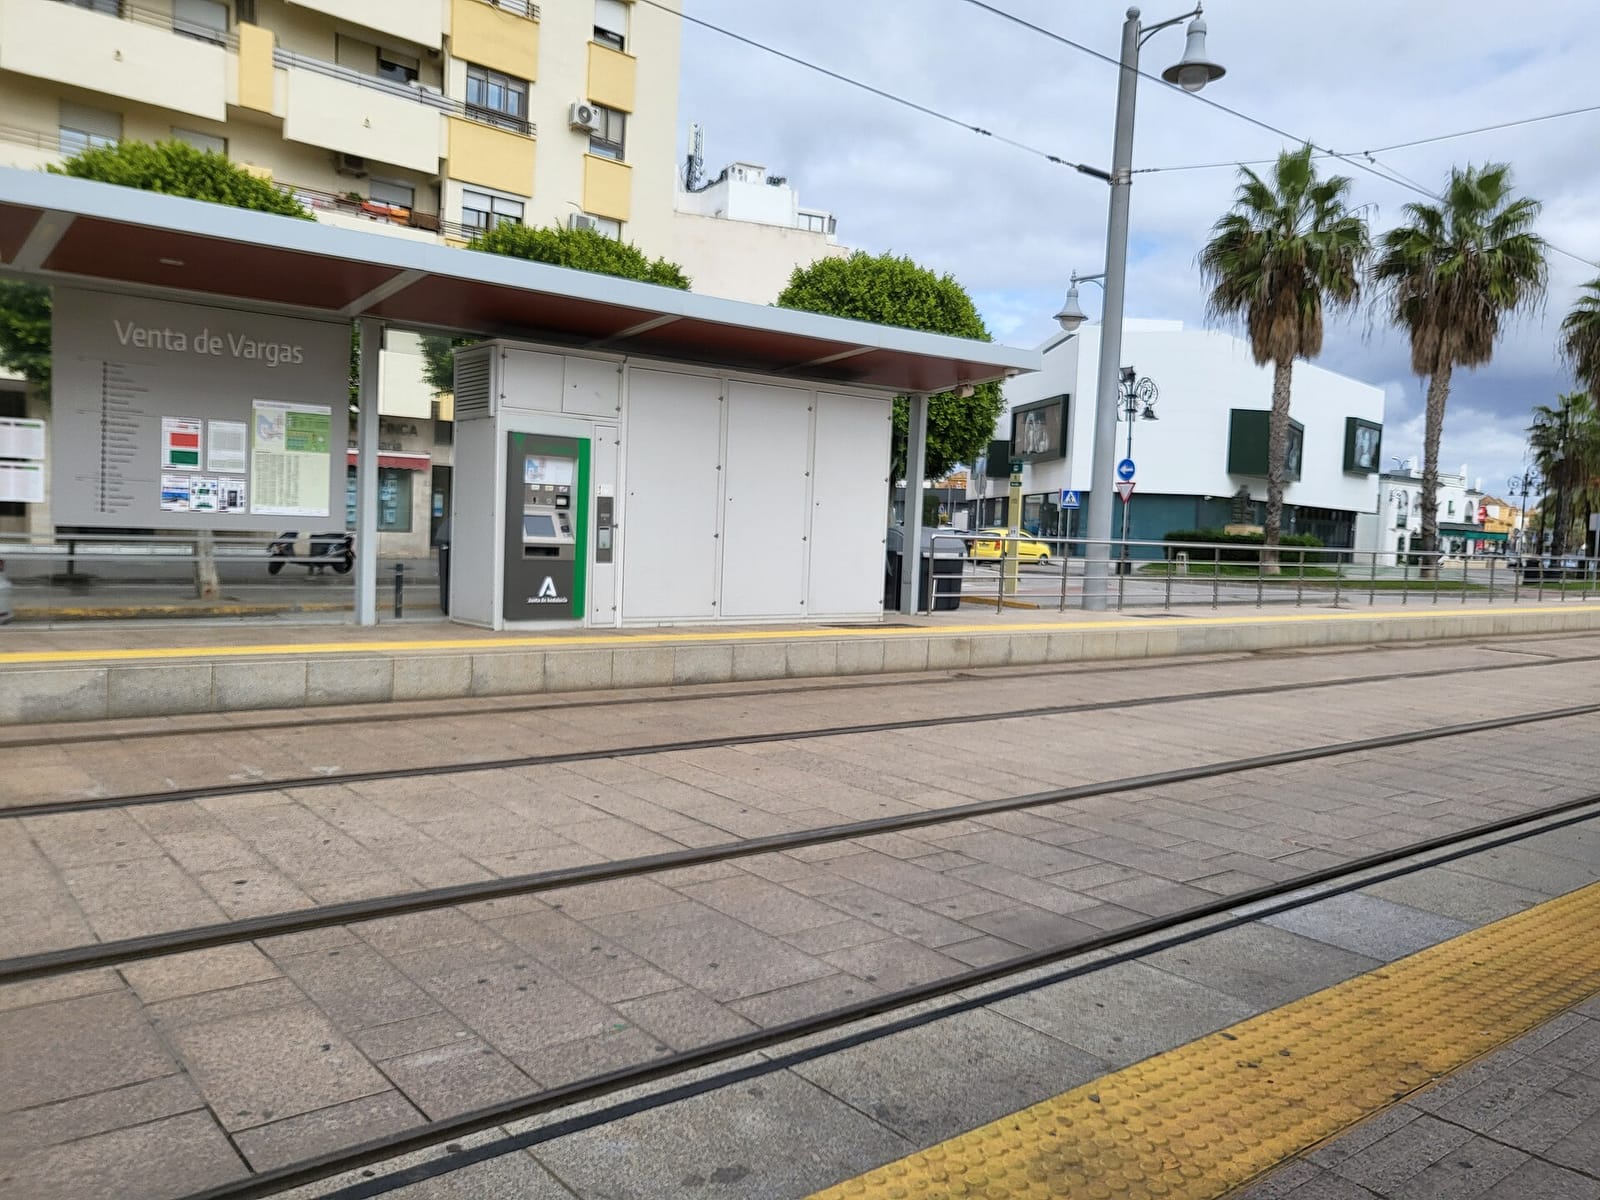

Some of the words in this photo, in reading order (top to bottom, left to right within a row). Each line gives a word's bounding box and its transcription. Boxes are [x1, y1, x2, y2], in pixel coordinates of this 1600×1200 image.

[113, 319, 188, 352] Venta
[193, 328, 224, 356] de
[227, 332, 304, 367] Vargas
